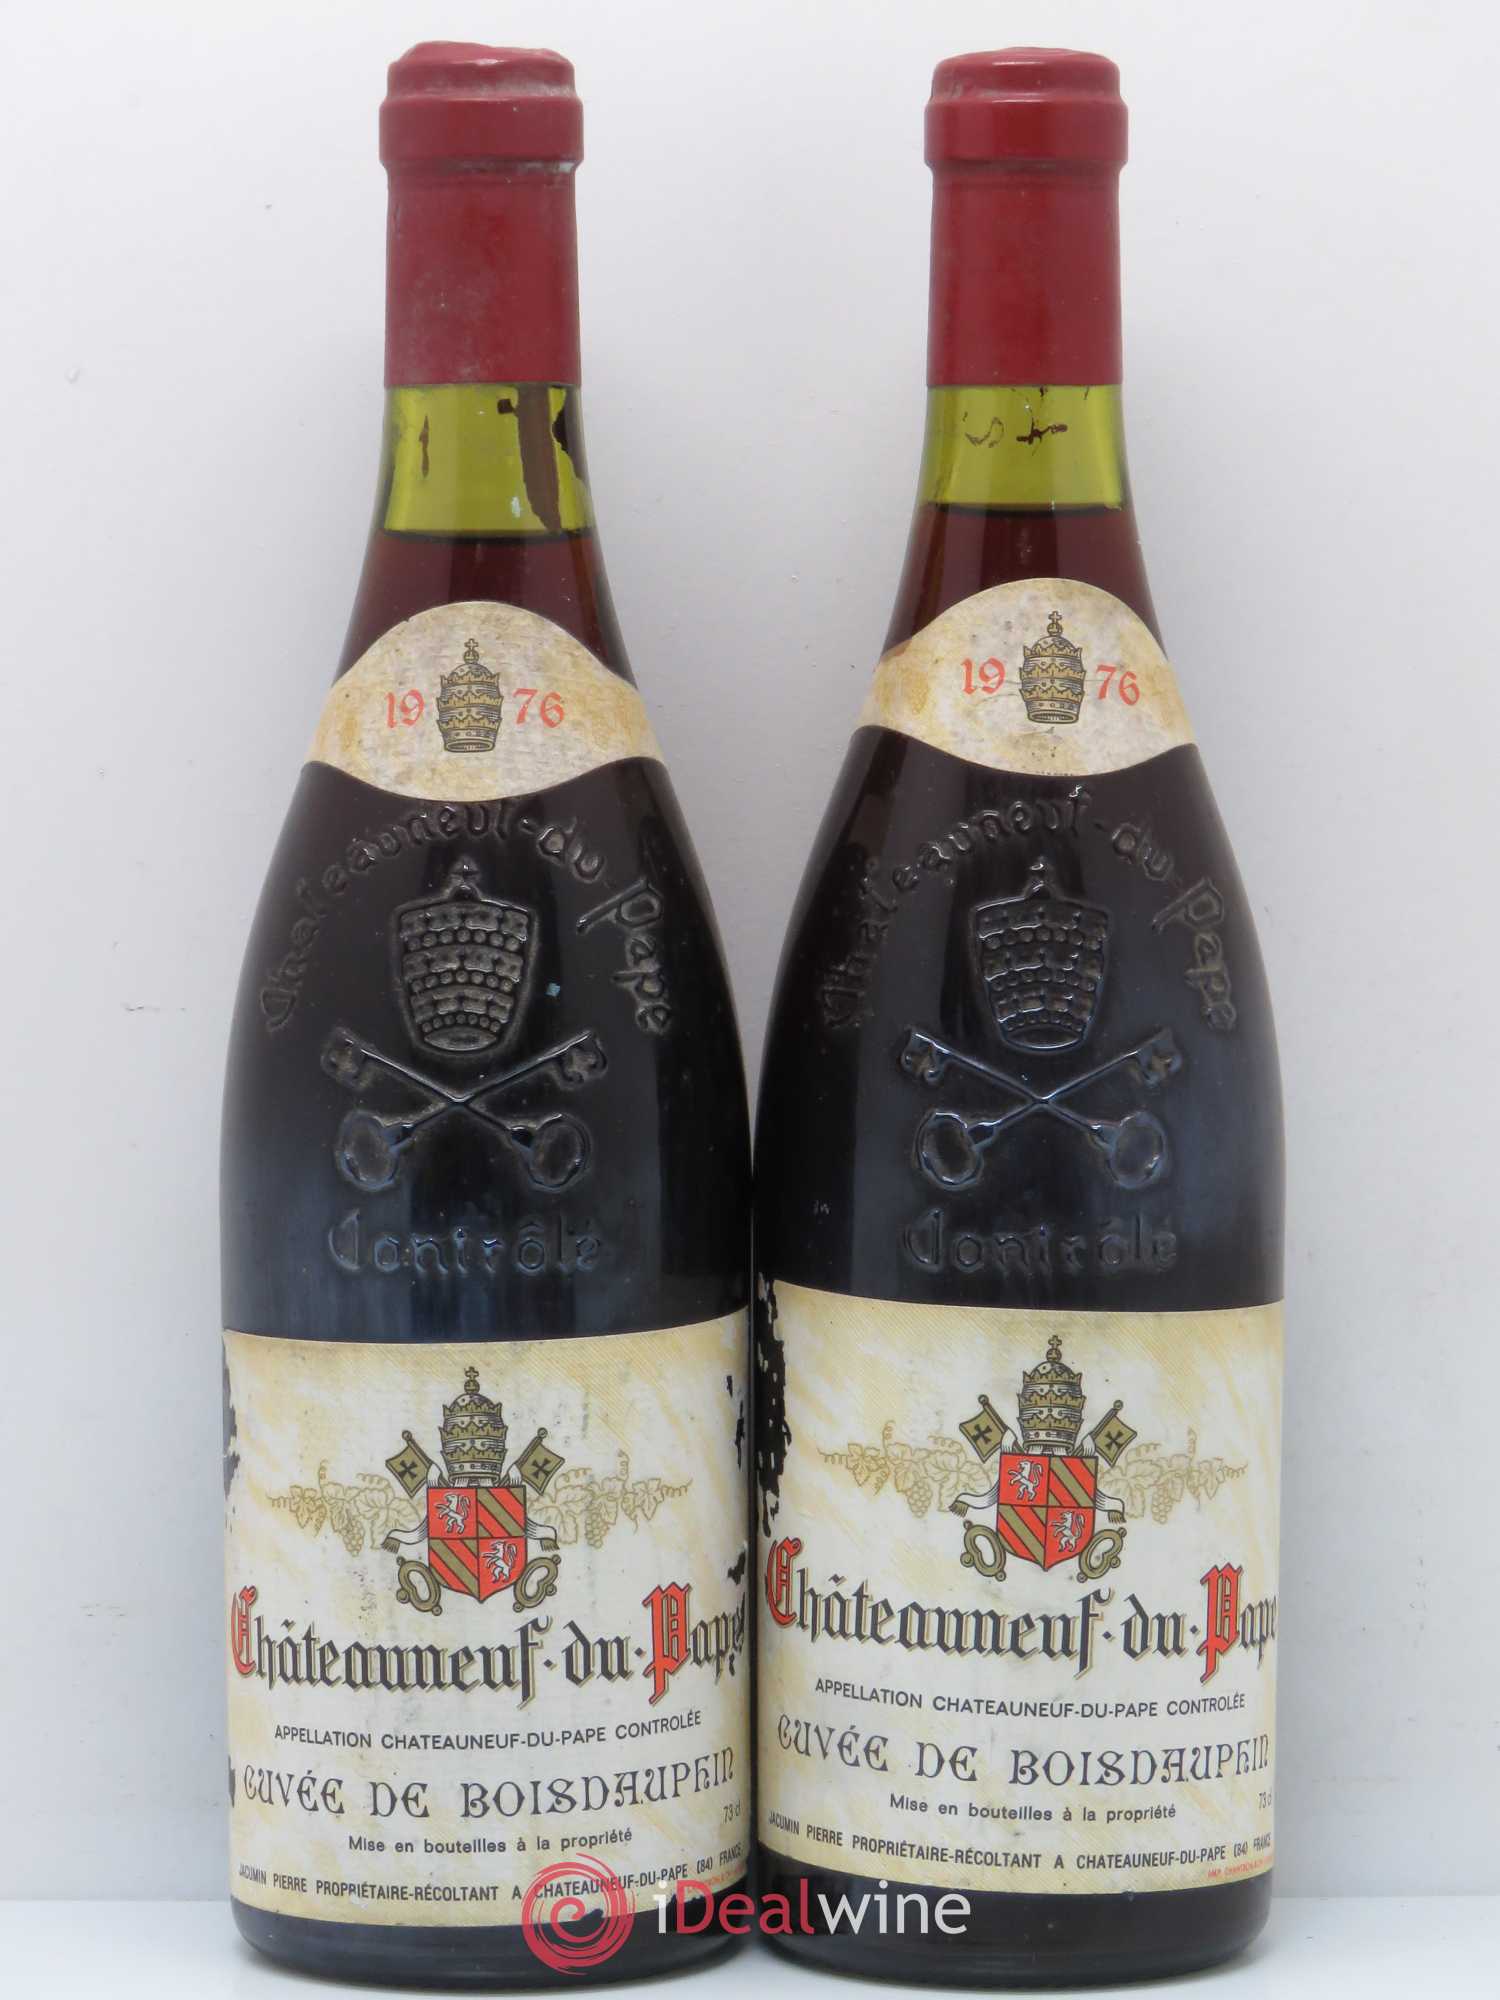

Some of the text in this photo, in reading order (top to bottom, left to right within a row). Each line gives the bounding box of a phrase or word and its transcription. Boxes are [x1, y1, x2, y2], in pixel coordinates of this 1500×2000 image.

[959, 657, 1141, 706] 19 76
[384, 688, 565, 729] 19 76
[815, 1677, 1246, 1718] APPELLATION CHATEAUNEUF-DU-PAPE CONTROLÉE
[274, 1709, 702, 1750] APPELLATION CHATEAUNEUF-DU-PAPE CONTROLÉE
[777, 1714, 889, 1772] CUVÉE
[914, 1741, 978, 1782] DE
[243, 1763, 346, 1815] CUVÉE
[368, 1780, 430, 1819] DE
[889, 1793, 1176, 1823] Mise en bouteilles à la propriété
[348, 1827, 633, 1854] Mise en bouteilles à la propriété
[768, 1810, 800, 1836] JACUMIN
[806, 1823, 844, 1847] PIERRE
[852, 1834, 1042, 1870] PROPRIÉTAIRE-RÉCOLTANT
[1053, 1854, 1065, 1869] A
[1076, 1844, 1227, 1870] CHATEAUNEUF-DU-PAPE
[1233, 1841, 1249, 1859] (84)
[238, 1862, 268, 1886] JACUMIN
[273, 1872, 308, 1893] PIERRE
[316, 1879, 499, 1903] PROPRIÉTAIRE-RÉCOLTANT
[511, 1885, 522, 1901] A
[534, 1862, 689, 1900] CHATEAUNEUF-DU-PAPE
[696, 1855, 713, 1875] (84)
